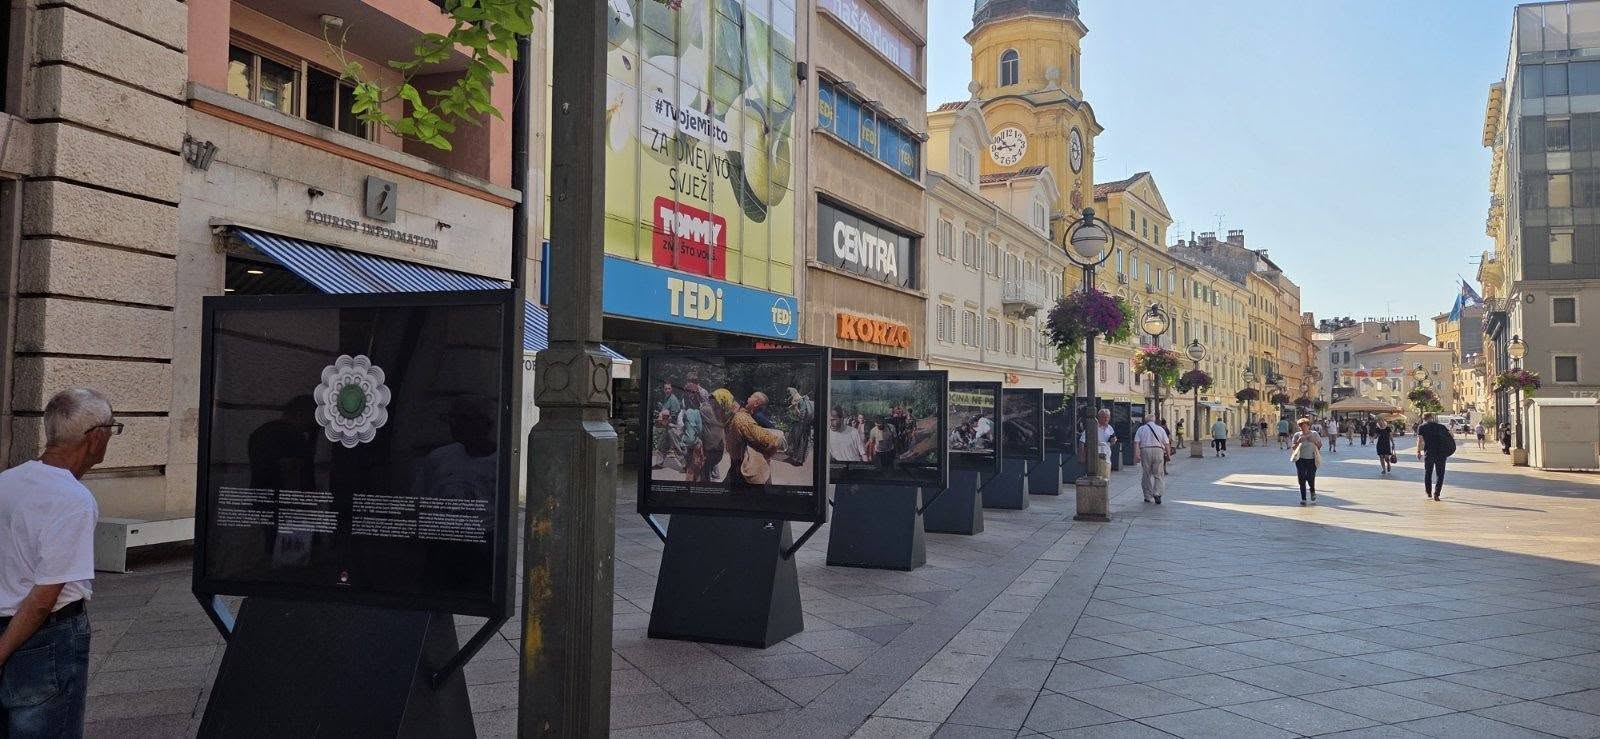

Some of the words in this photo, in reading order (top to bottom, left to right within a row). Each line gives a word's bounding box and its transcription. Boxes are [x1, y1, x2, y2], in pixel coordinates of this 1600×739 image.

[1006, 129, 1013, 137] 12
[1020, 141, 1026, 149] 3
[651, 127, 669, 157] ZA
[676, 137, 730, 179] DNEVNO
[669, 167, 714, 202] SVJEŽ
[305, 209, 360, 232] TOURIST
[362, 222, 438, 249] INFORMATION
[660, 206, 722, 247] TOMMY
[833, 220, 898, 277] CENTRA
[667, 277, 723, 322] TEDi
[771, 307, 792, 326] TEDi
[837, 313, 912, 348] KORZO
